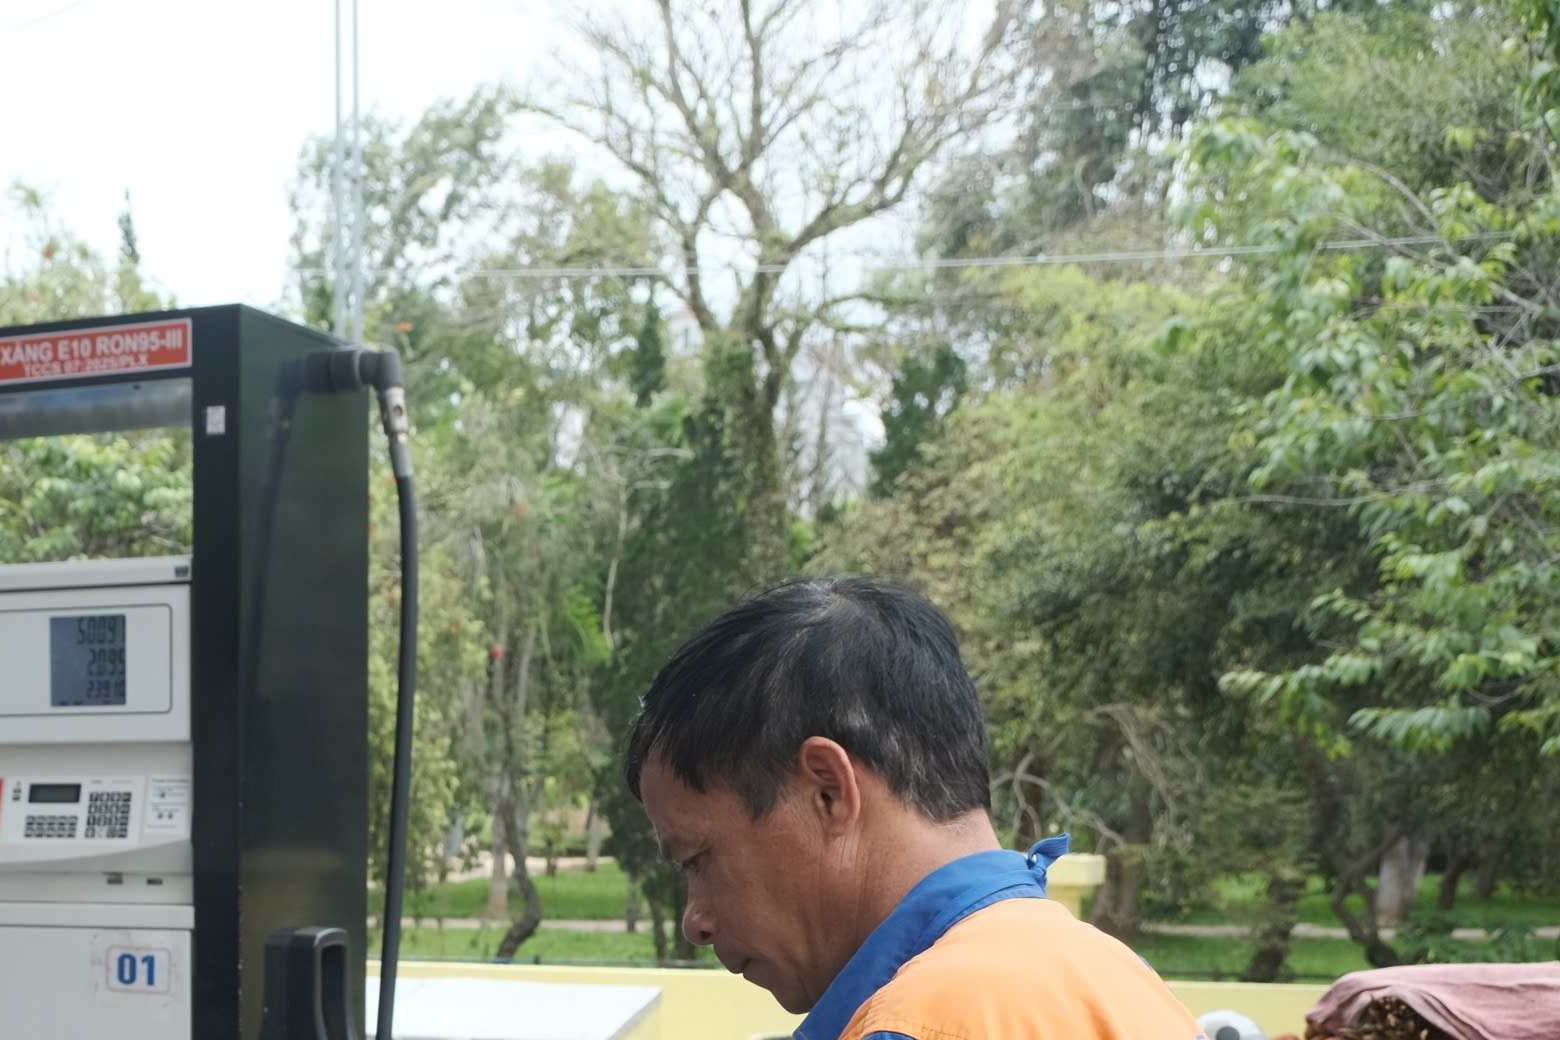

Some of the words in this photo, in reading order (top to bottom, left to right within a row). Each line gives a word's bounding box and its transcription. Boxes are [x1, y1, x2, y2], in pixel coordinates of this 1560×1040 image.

[57, 338, 92, 361] E10
[95, 328, 184, 356] RON95-III
[116, 952, 157, 987] 01
